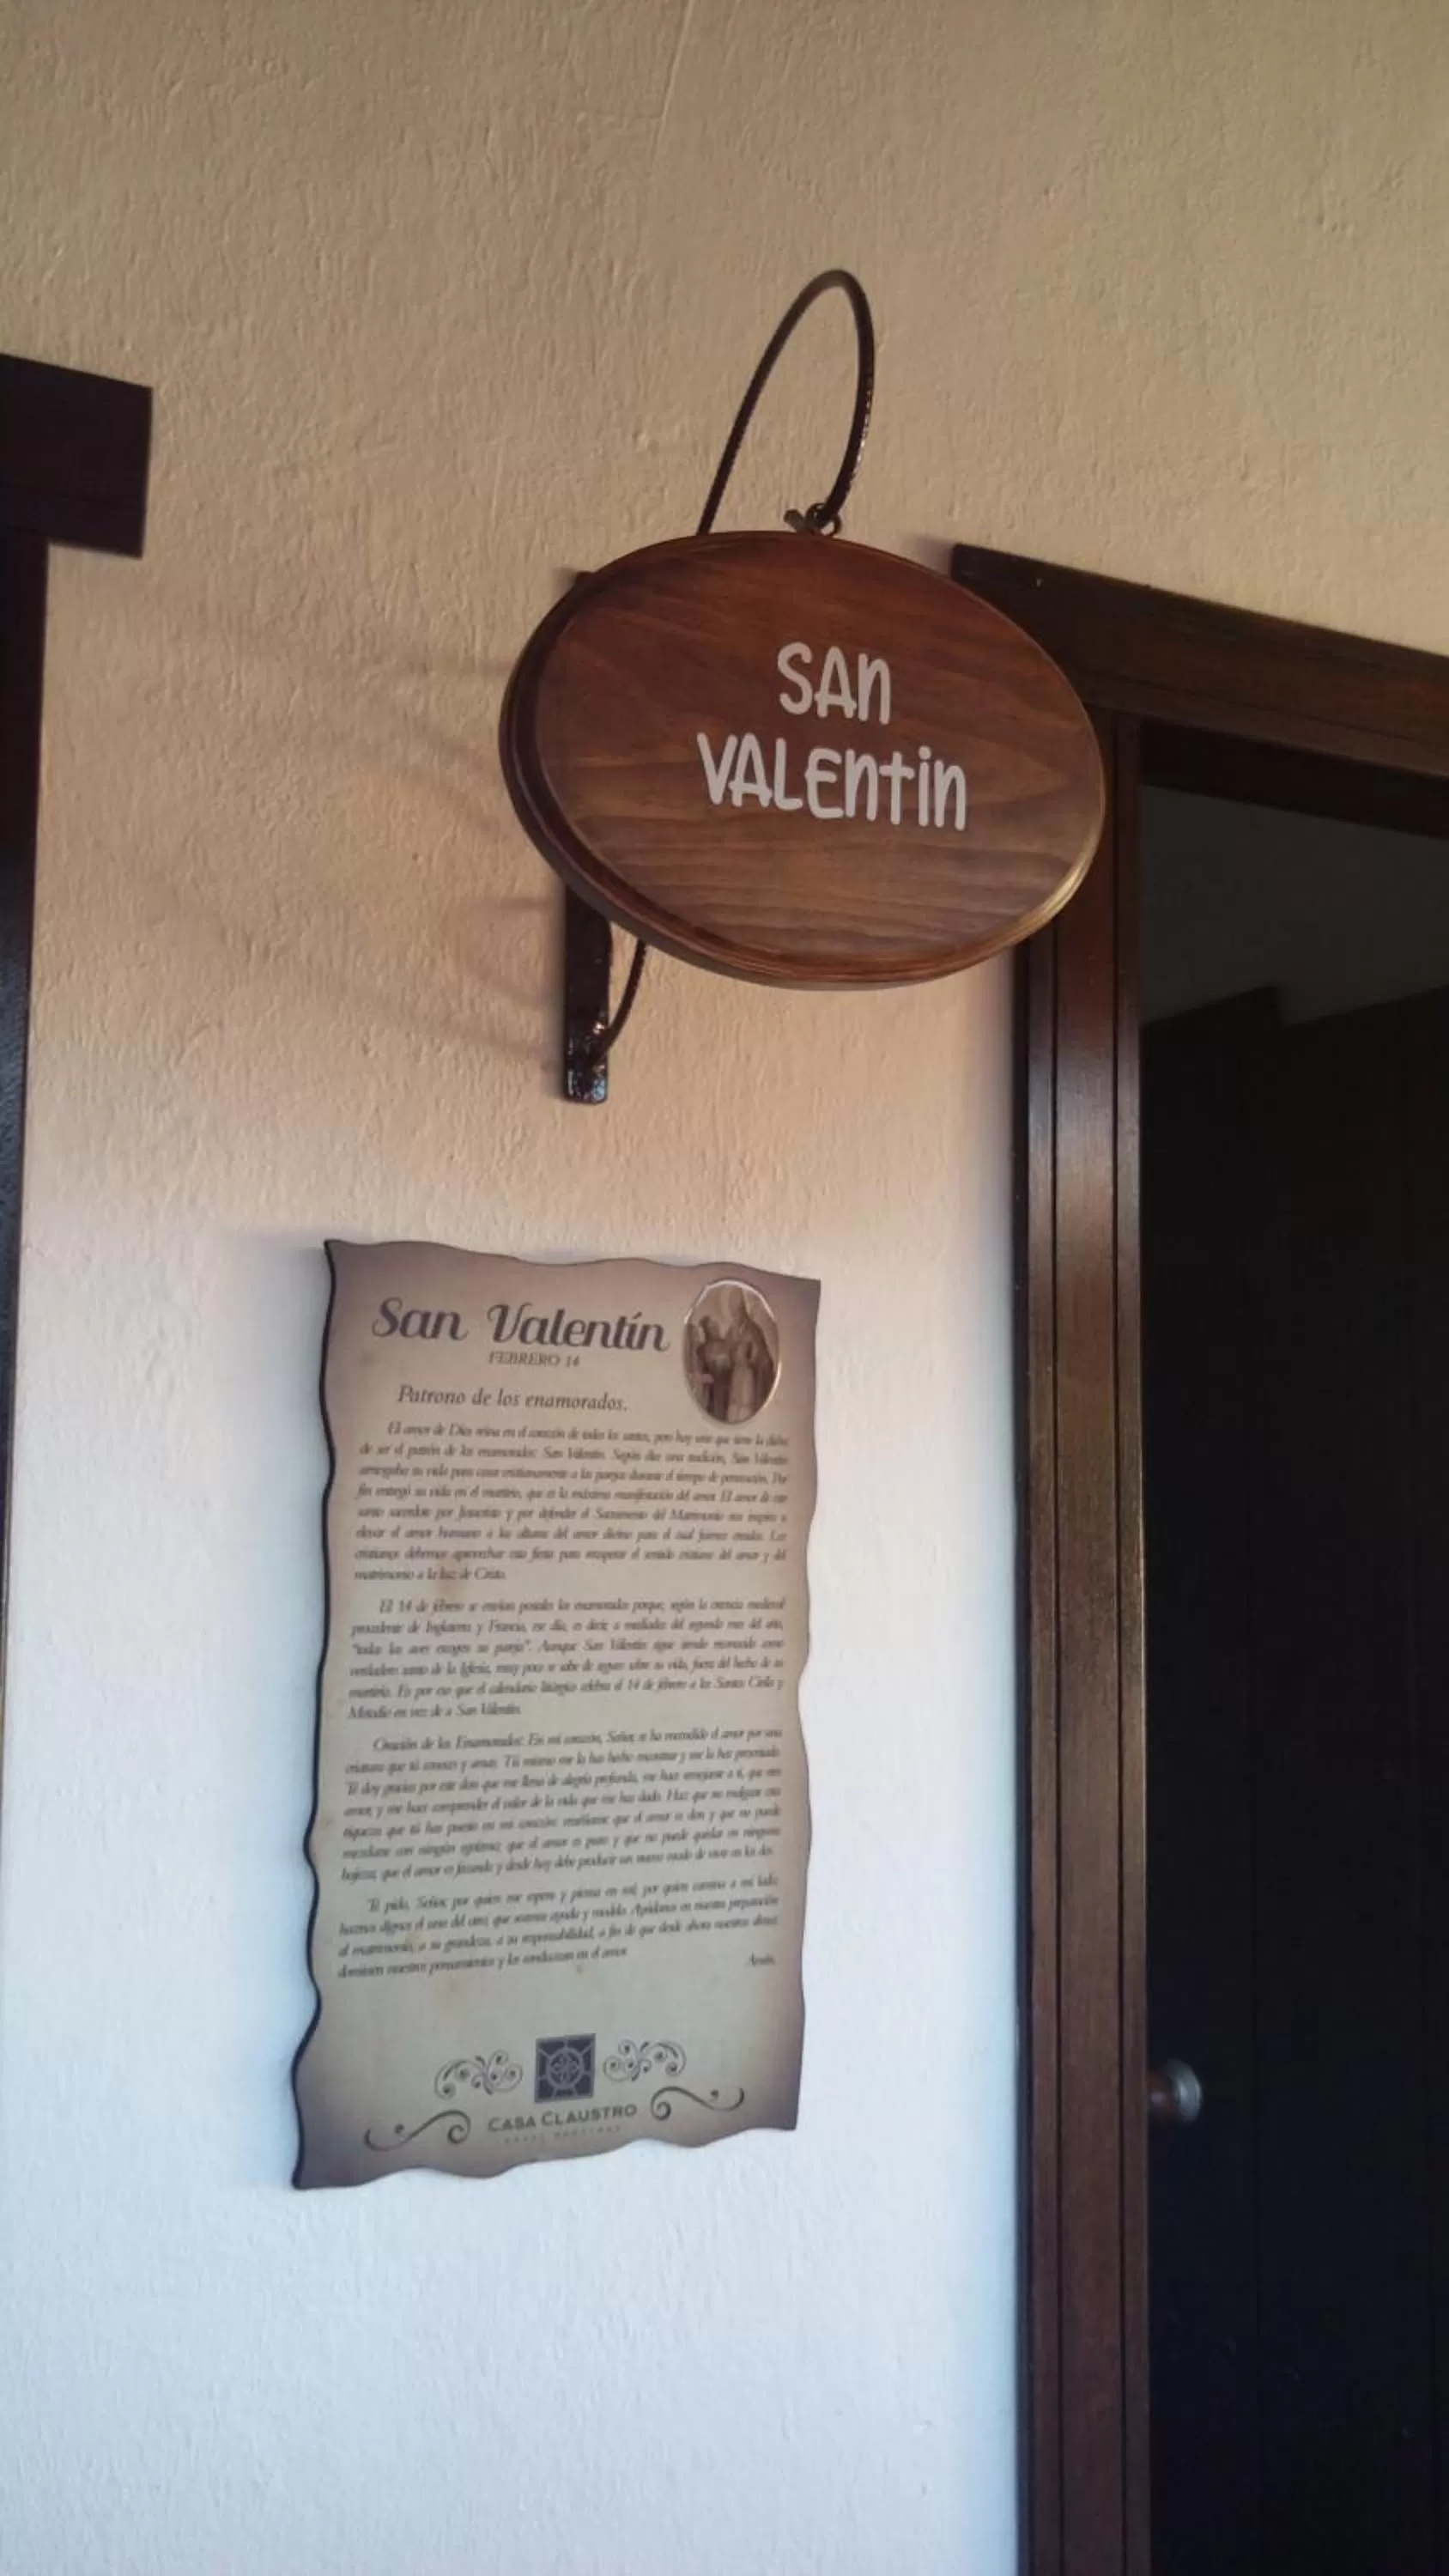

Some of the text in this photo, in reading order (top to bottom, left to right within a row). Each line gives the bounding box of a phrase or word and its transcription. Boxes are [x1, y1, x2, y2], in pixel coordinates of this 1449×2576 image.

[372, 1297, 670, 1352] San Valentín
[488, 1351, 580, 1368] FEBRERO 14
[397, 1383, 631, 1413] Patrono de los enamorados.
[487, 2103, 639, 2132] CASA CLAUSTRO
